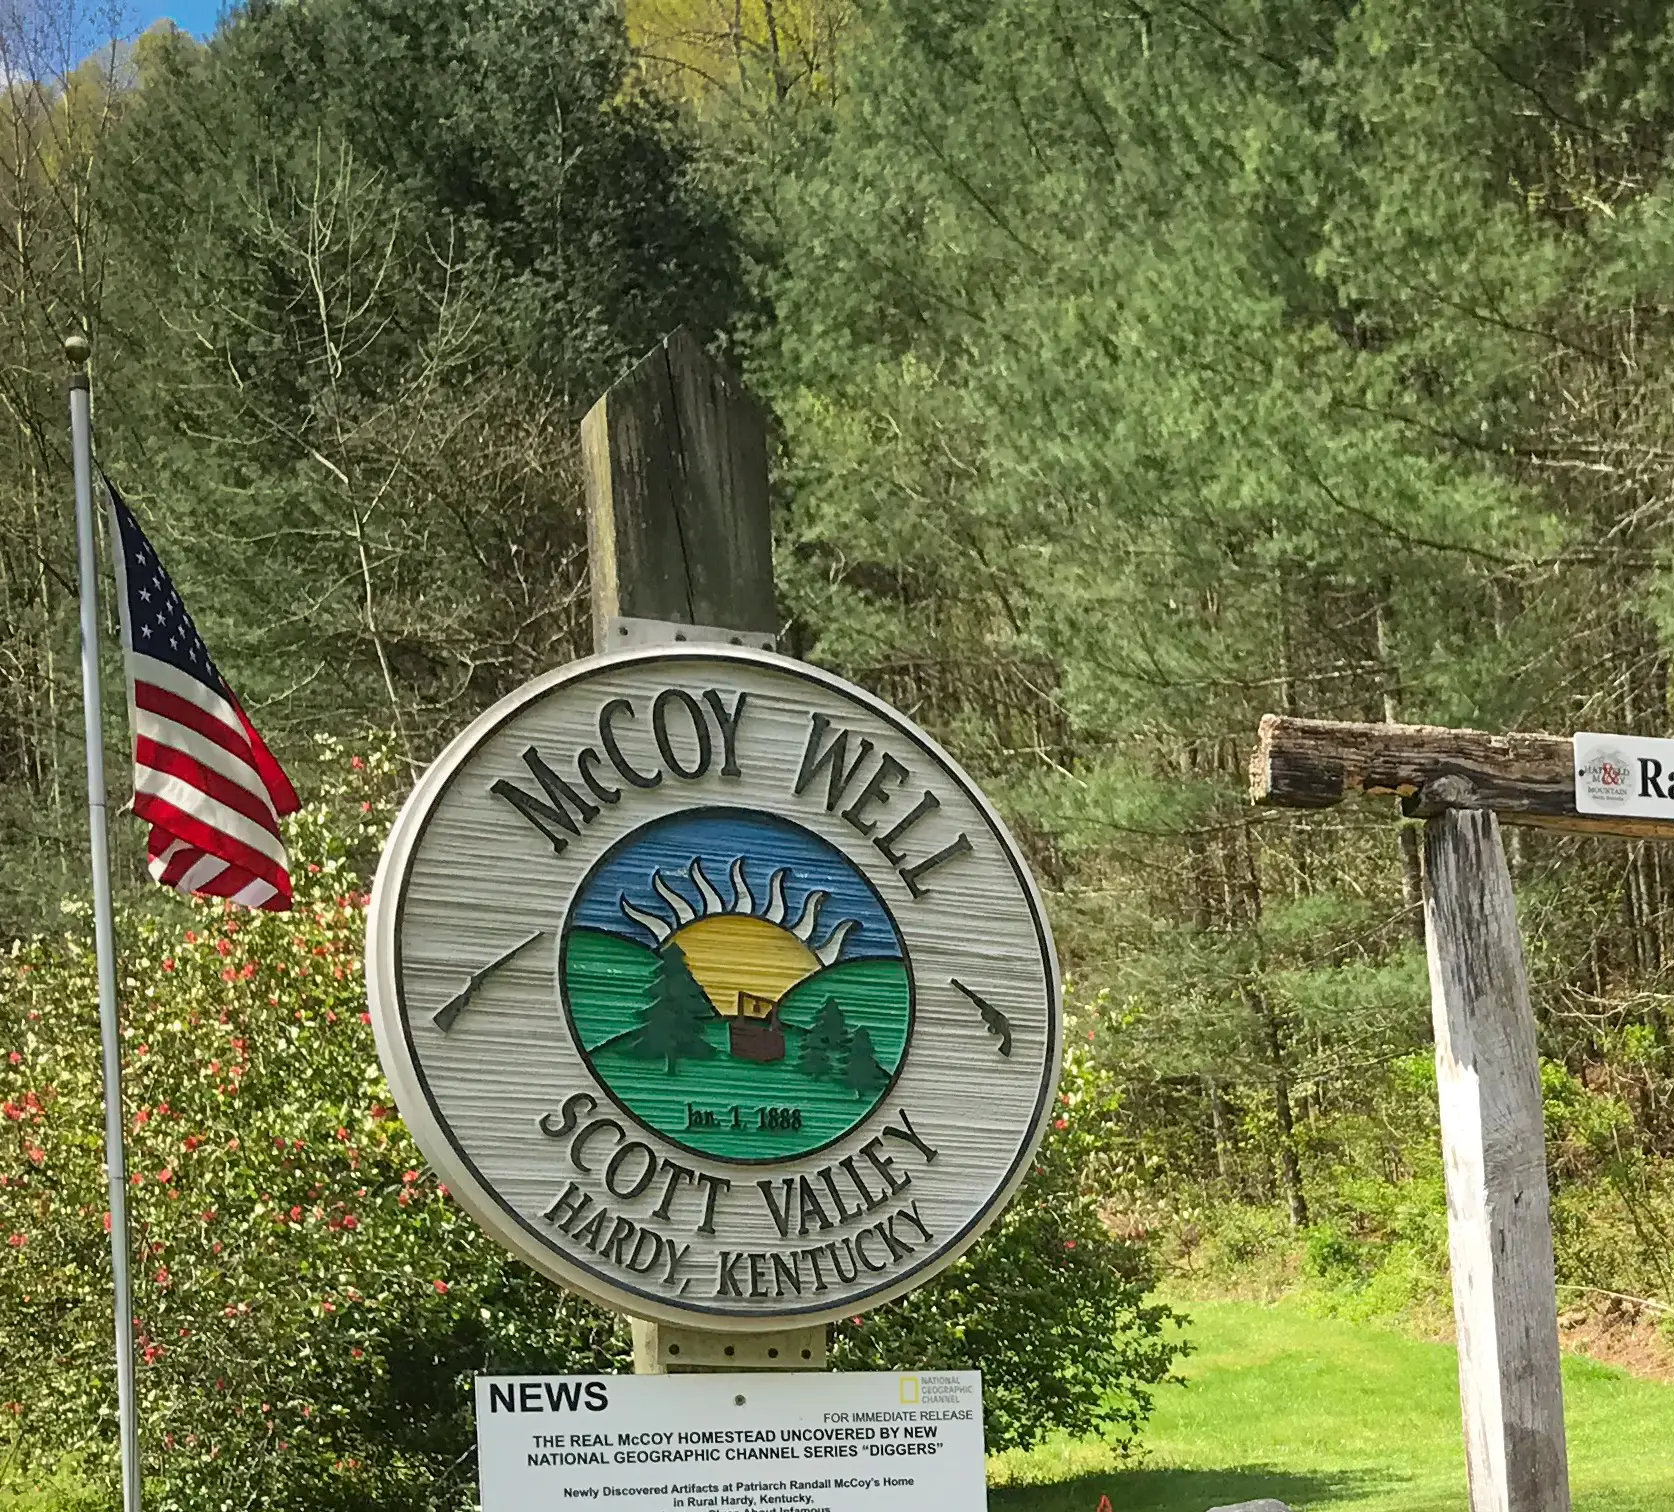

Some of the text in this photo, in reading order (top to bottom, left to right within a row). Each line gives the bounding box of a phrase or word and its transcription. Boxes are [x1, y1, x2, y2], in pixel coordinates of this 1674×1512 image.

[490, 687, 974, 900] McCOY WELL
[755, 1106, 803, 1130] 1888
[538, 1090, 940, 1239] SCOTT VALLEY
[543, 1180, 938, 1298] HARDY, KENTUCKY
[921, 1376, 961, 1385] NATIONAL
[921, 1385, 973, 1394] GEOGRAPHIC
[489, 1381, 609, 1413] NEWS
[921, 1395, 960, 1404] CHANNEL
[824, 1409, 972, 1423] FOR IMMEDIATE RELEASE
[532, 1426, 937, 1448] THE REAL McCOY HOMESTEAD UNCOVERED BY NEW
[528, 1452, 609, 1466] NATIONAL
[614, 1448, 720, 1463] GEOGRAPHIC
[725, 1446, 799, 1460] CHANNEL
[804, 1444, 857, 1458] SERIES
[564, 1487, 598, 1499] Newly
[603, 1484, 668, 1496] Discovered
[670, 1483, 718, 1493] Artifacts
[721, 1483, 732, 1492] at
[736, 1481, 786, 1490] Patriarch
[790, 1479, 830, 1489] Randall
[883, 1477, 914, 1486] Home
[673, 1493, 814, 1507] in Rural Hardy, Kentucky,
